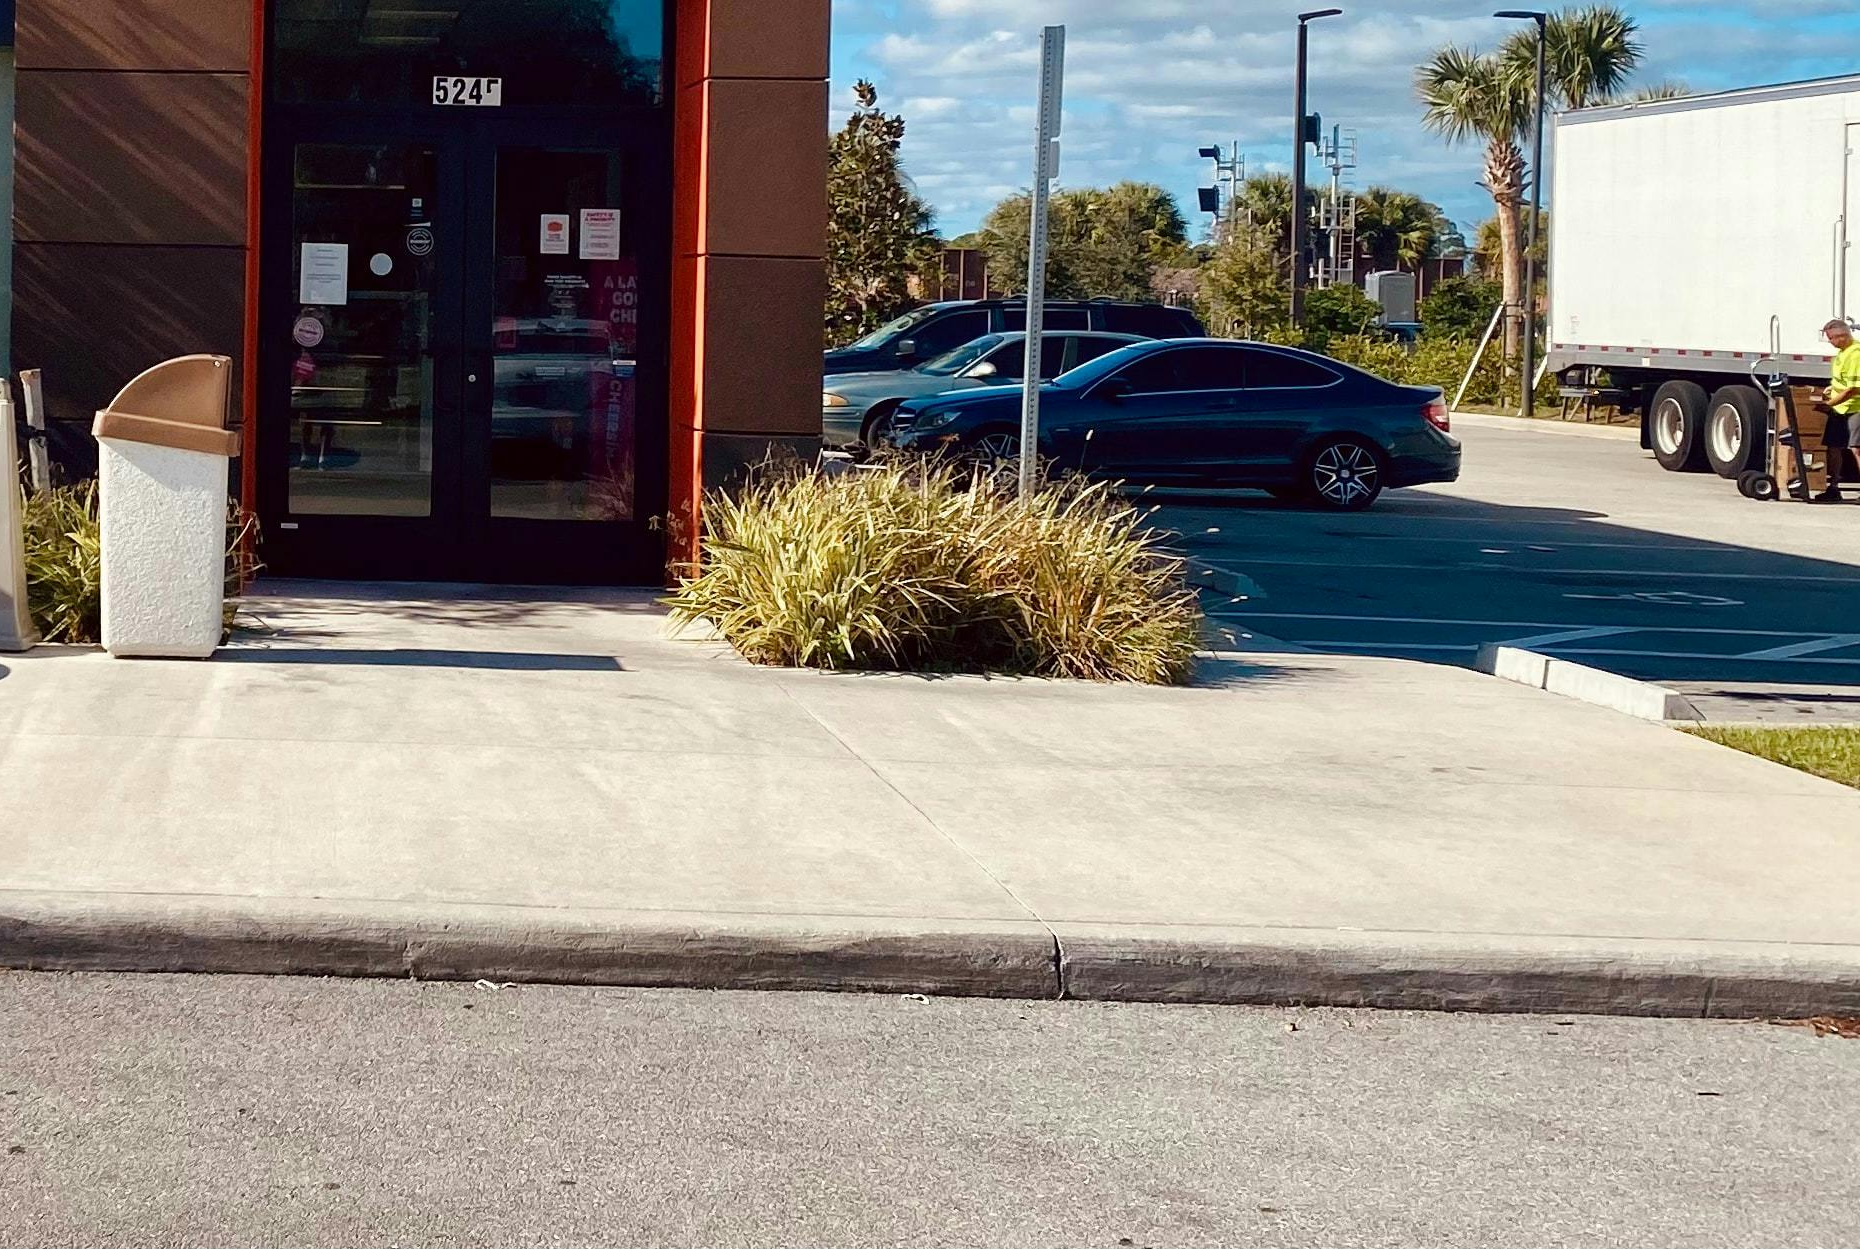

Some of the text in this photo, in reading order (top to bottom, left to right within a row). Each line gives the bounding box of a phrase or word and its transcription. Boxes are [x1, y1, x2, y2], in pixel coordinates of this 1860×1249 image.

[603, 275, 614, 289] A
[617, 275, 638, 289] LA
[612, 291, 638, 306] GO
